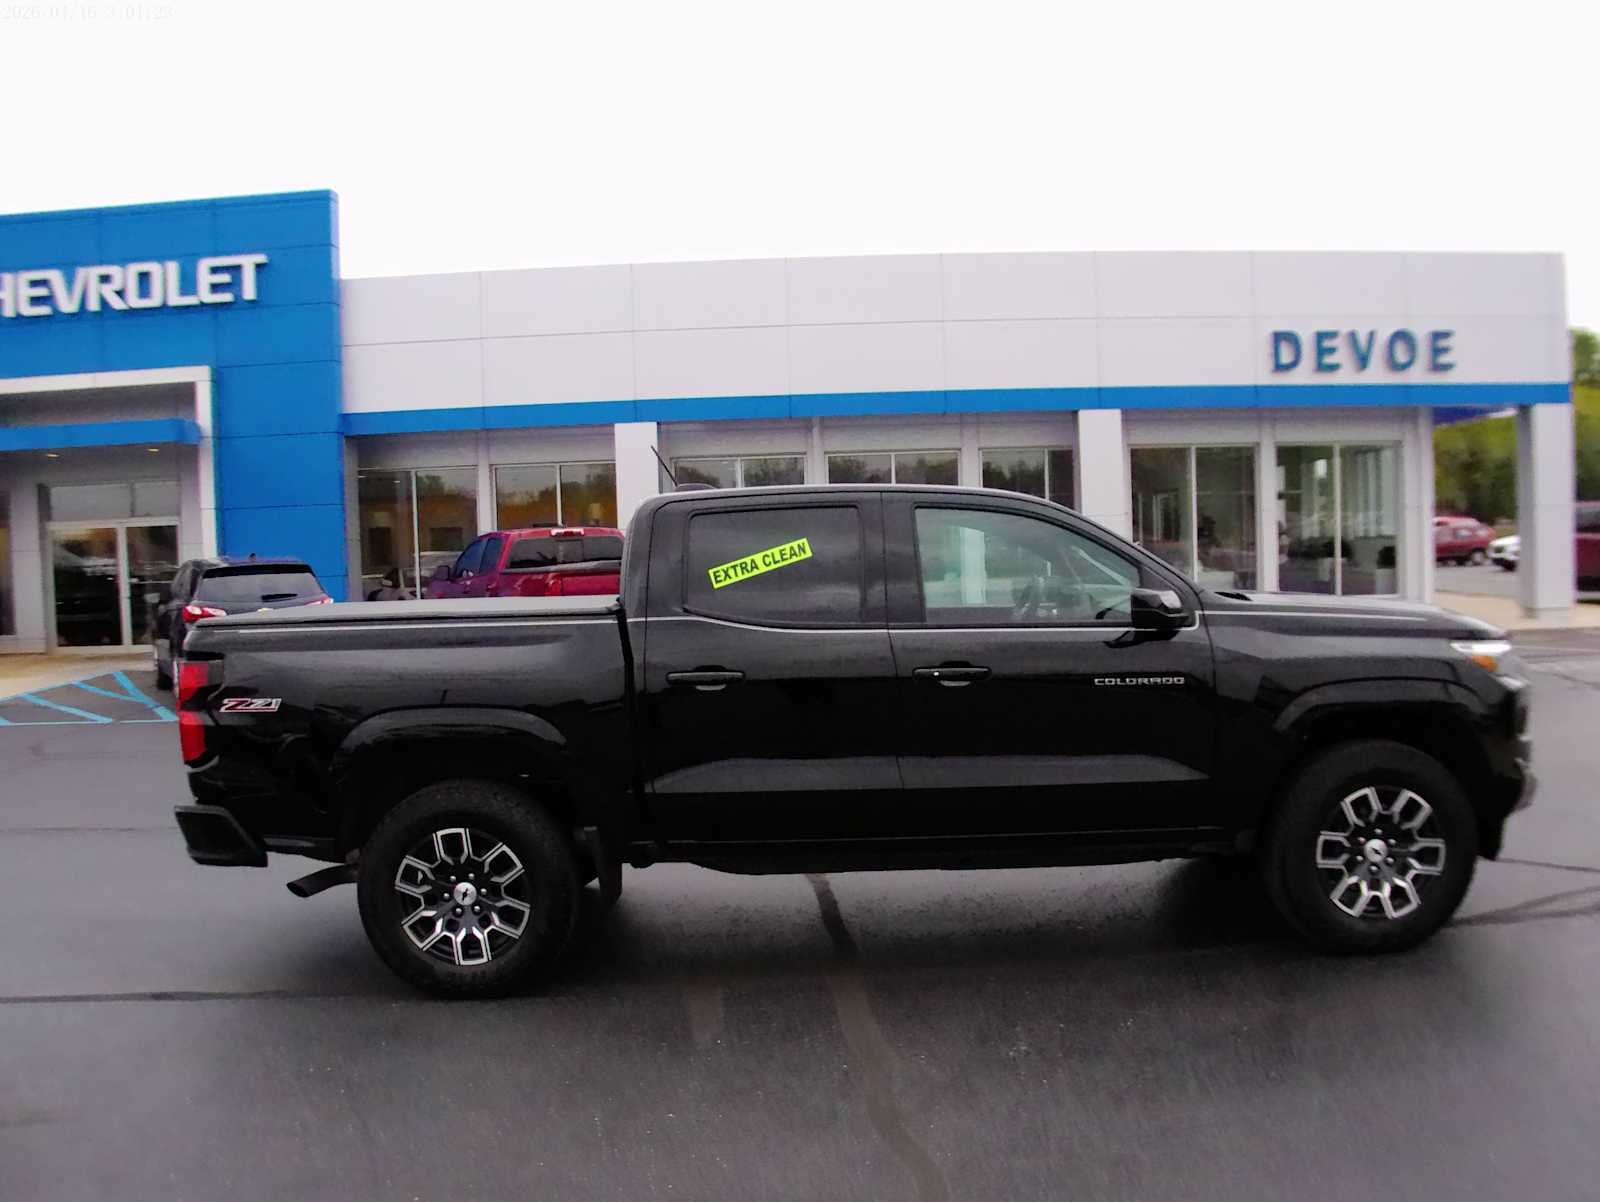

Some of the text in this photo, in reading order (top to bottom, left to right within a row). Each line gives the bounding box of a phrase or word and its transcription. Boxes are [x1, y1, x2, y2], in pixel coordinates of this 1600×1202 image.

[1271, 328, 1457, 374] DEVOE
[712, 542, 807, 585] EXTRA CLEAN
[1093, 676, 1185, 686] COLORADO
